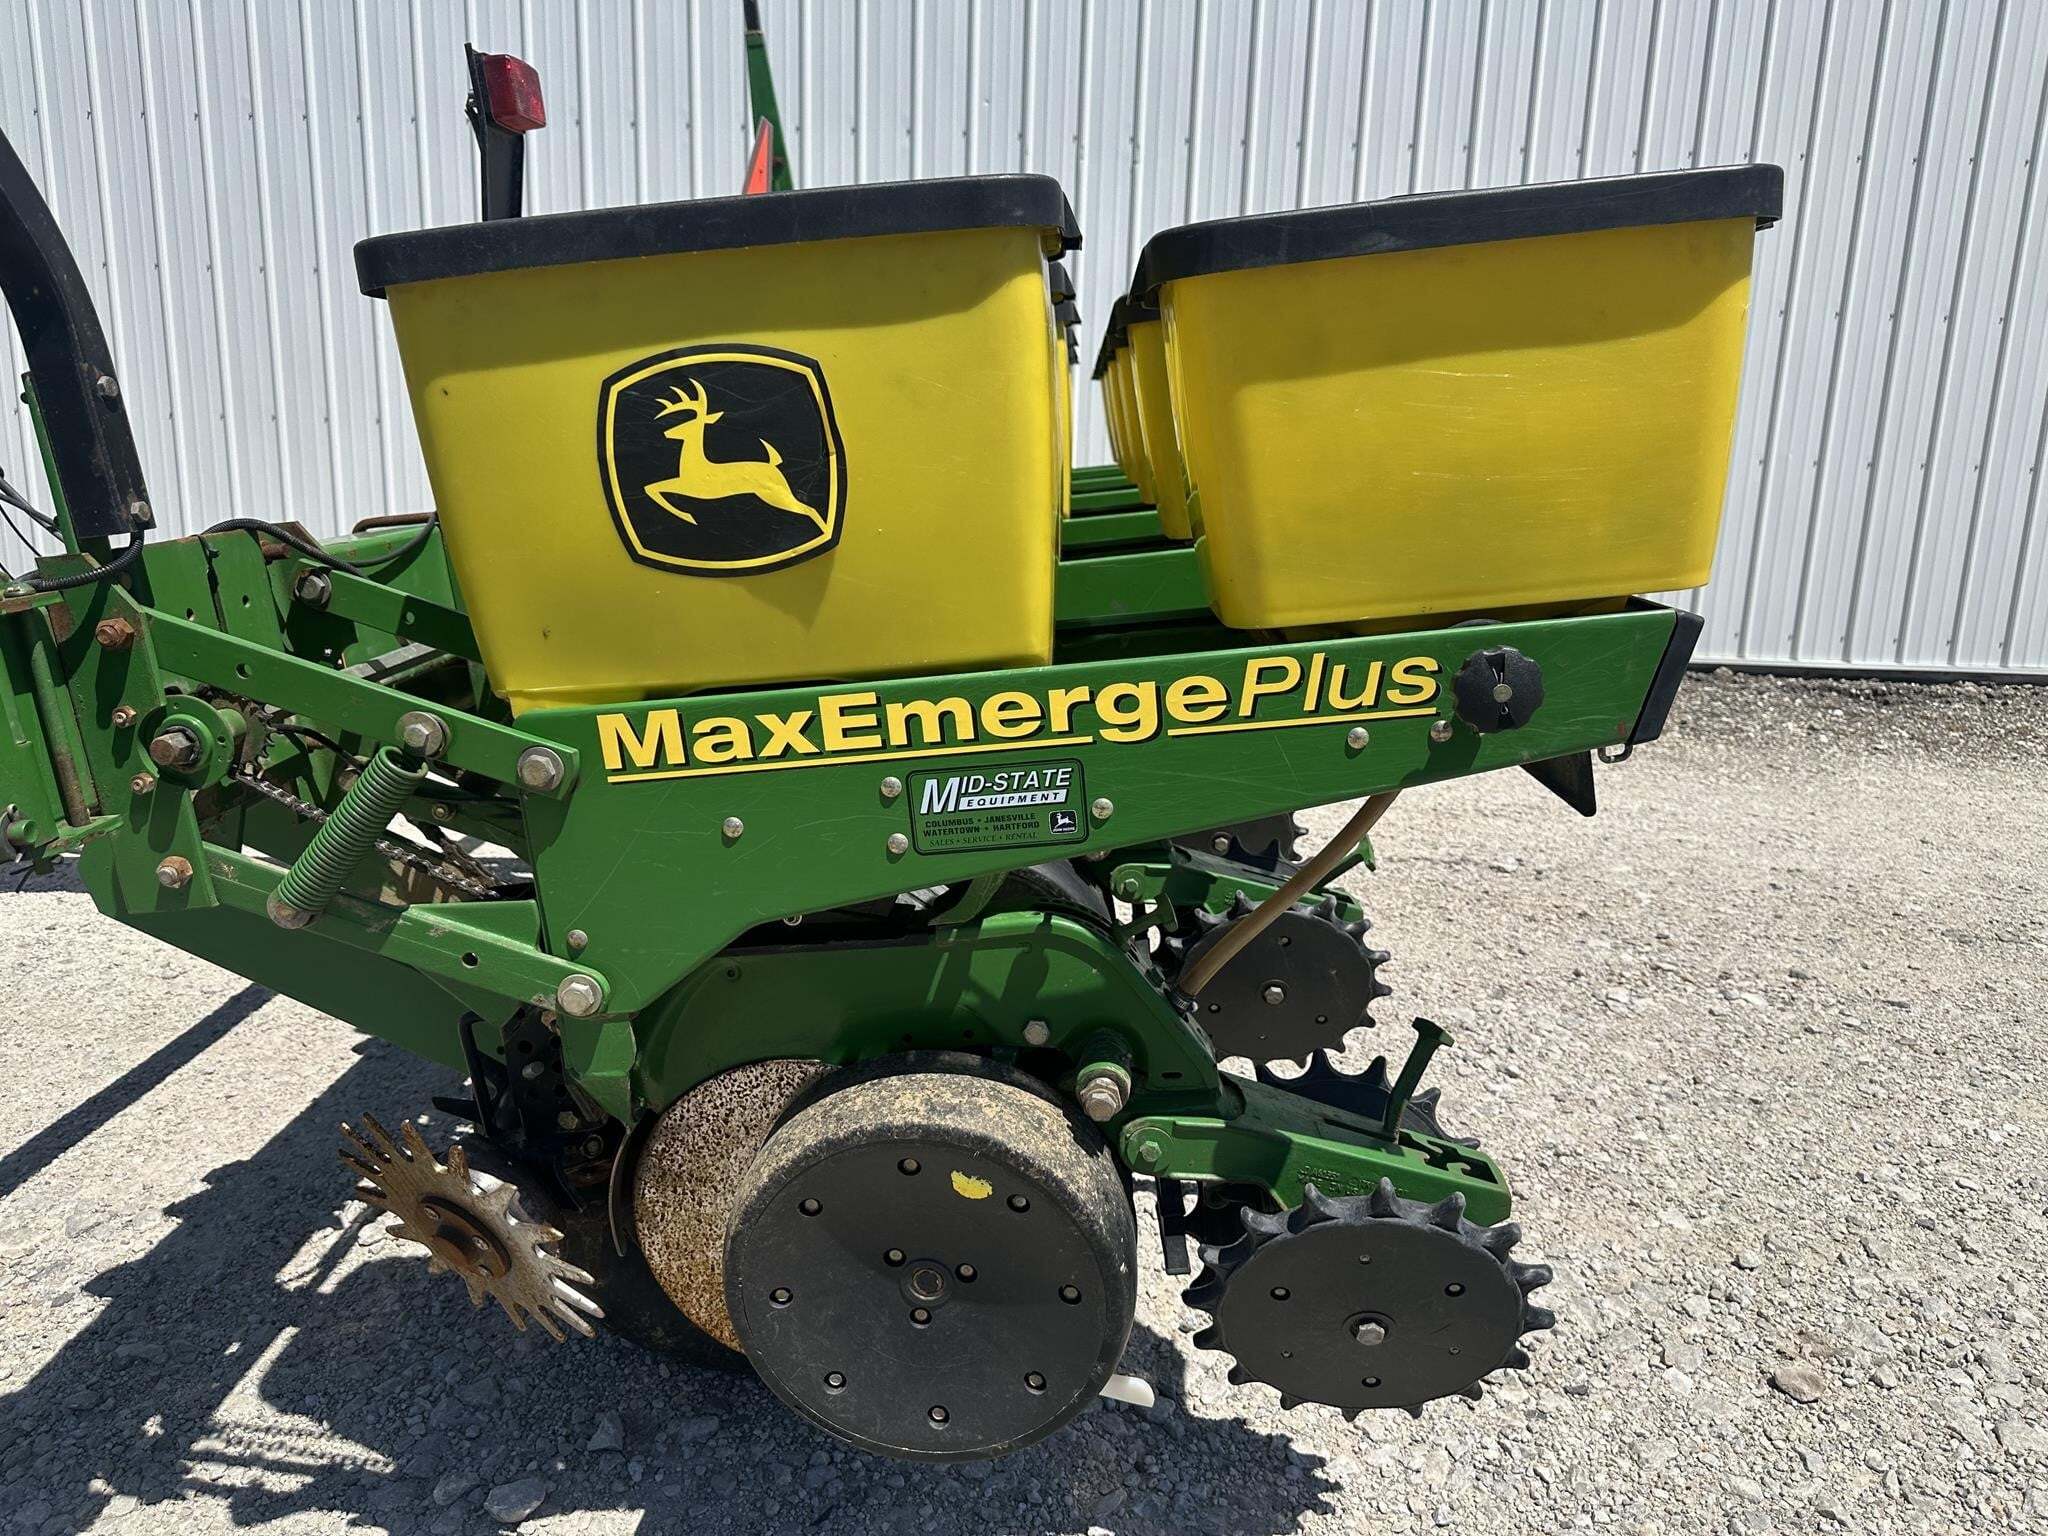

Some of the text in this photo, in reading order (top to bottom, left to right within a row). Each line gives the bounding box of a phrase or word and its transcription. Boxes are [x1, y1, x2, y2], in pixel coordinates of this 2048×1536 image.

[919, 767, 1073, 815] MID-STATE
[966, 791, 1061, 808] EQUIPMENT
[925, 812, 1037, 828] COLUMBUS JANESVILLE
[923, 826, 980, 838] WATERTOWN
[992, 820, 1040, 832] HARTFORD
[929, 831, 1039, 848] SALES SERVICE RENTAL
